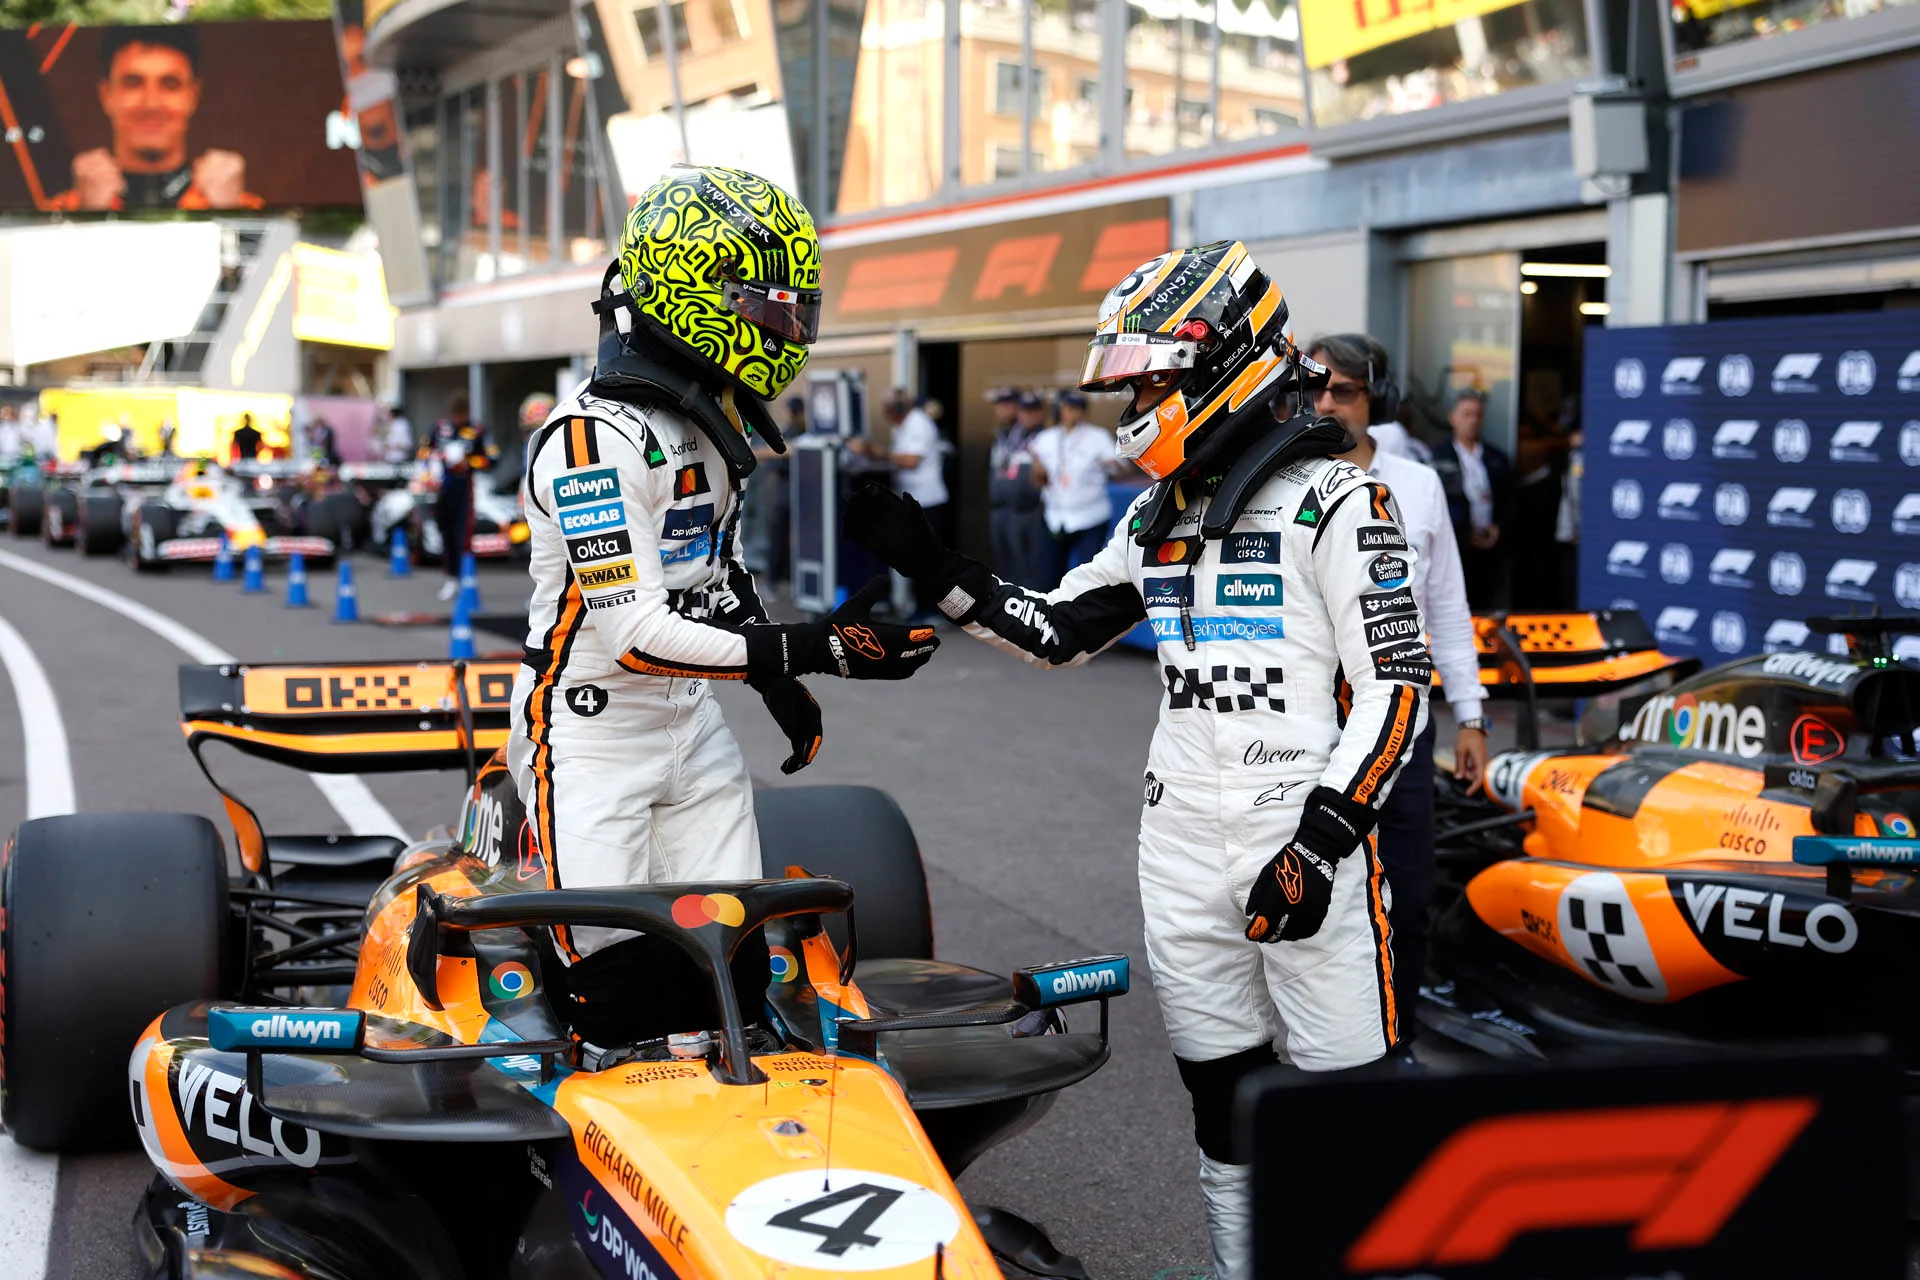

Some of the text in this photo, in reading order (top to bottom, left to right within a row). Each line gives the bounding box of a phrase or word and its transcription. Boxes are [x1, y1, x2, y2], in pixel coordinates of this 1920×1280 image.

[1223, 343, 1248, 368] OSCAR
[558, 476, 614, 498] allwyn
[563, 508, 621, 530] ECOLAB
[577, 539, 620, 559] okta
[1362, 532, 1382, 546] JACK
[1375, 561, 1403, 572] Estrella
[1378, 569, 1402, 580] Galicia
[587, 589, 636, 610] PIRELLI
[1224, 579, 1275, 601] allwyn
[1372, 619, 1417, 641] ARROW
[1763, 651, 1860, 686] allwyn
[574, 688, 598, 713] 4
[1243, 739, 1306, 766] Oscar
[1358, 718, 1405, 799] RICHAR MILLE
[1788, 769, 1816, 790] okta
[1719, 832, 1767, 855] CISCO
[1846, 842, 1913, 864] allwyn
[1683, 882, 1859, 954] VELO
[368, 974, 389, 1009] CISCO
[1053, 967, 1117, 993] allwyn
[252, 1015, 341, 1044] allwyn
[530, 1160, 553, 1191] Bahrain
[584, 1120, 689, 1256] RICHARD MILLE
[766, 1182, 904, 1257] 4
[602, 1215, 623, 1258] DP
